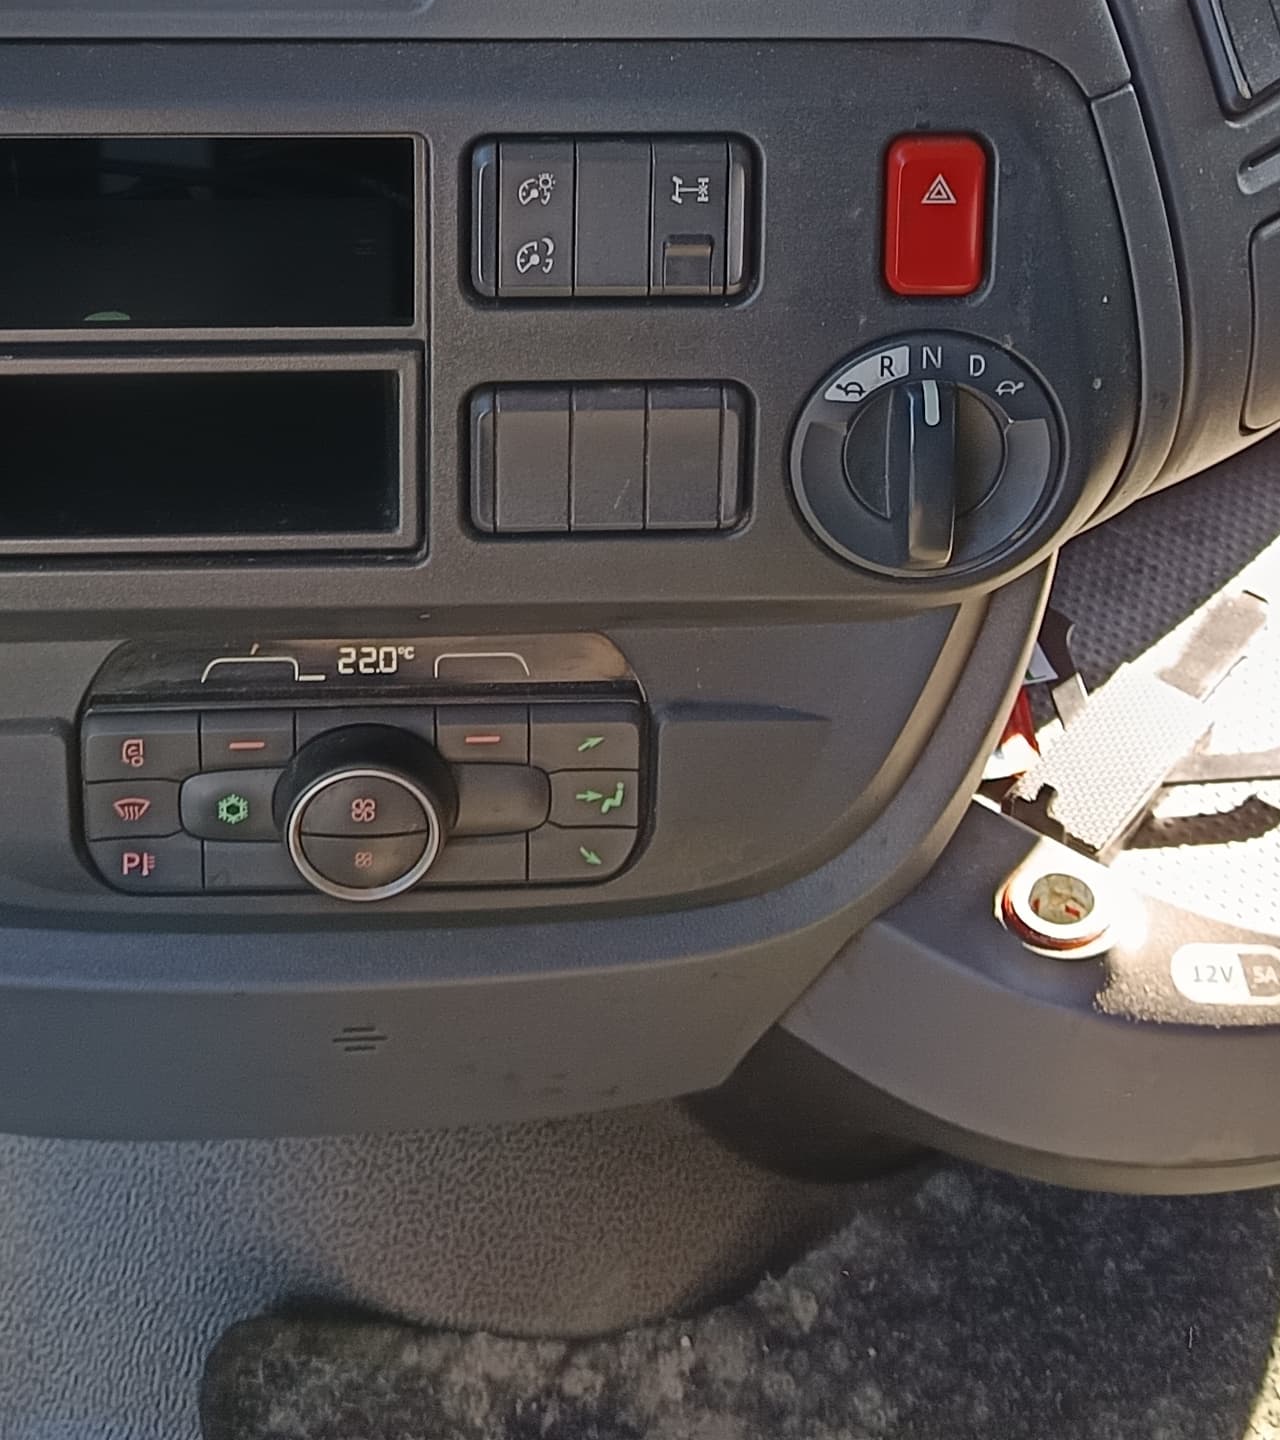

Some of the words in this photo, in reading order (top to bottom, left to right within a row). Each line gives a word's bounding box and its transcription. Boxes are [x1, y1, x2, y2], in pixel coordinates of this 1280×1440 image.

[880, 355, 895, 377] R
[922, 346, 942, 368] N
[969, 354, 986, 377] D
[1193, 965, 1233, 984] 12V
